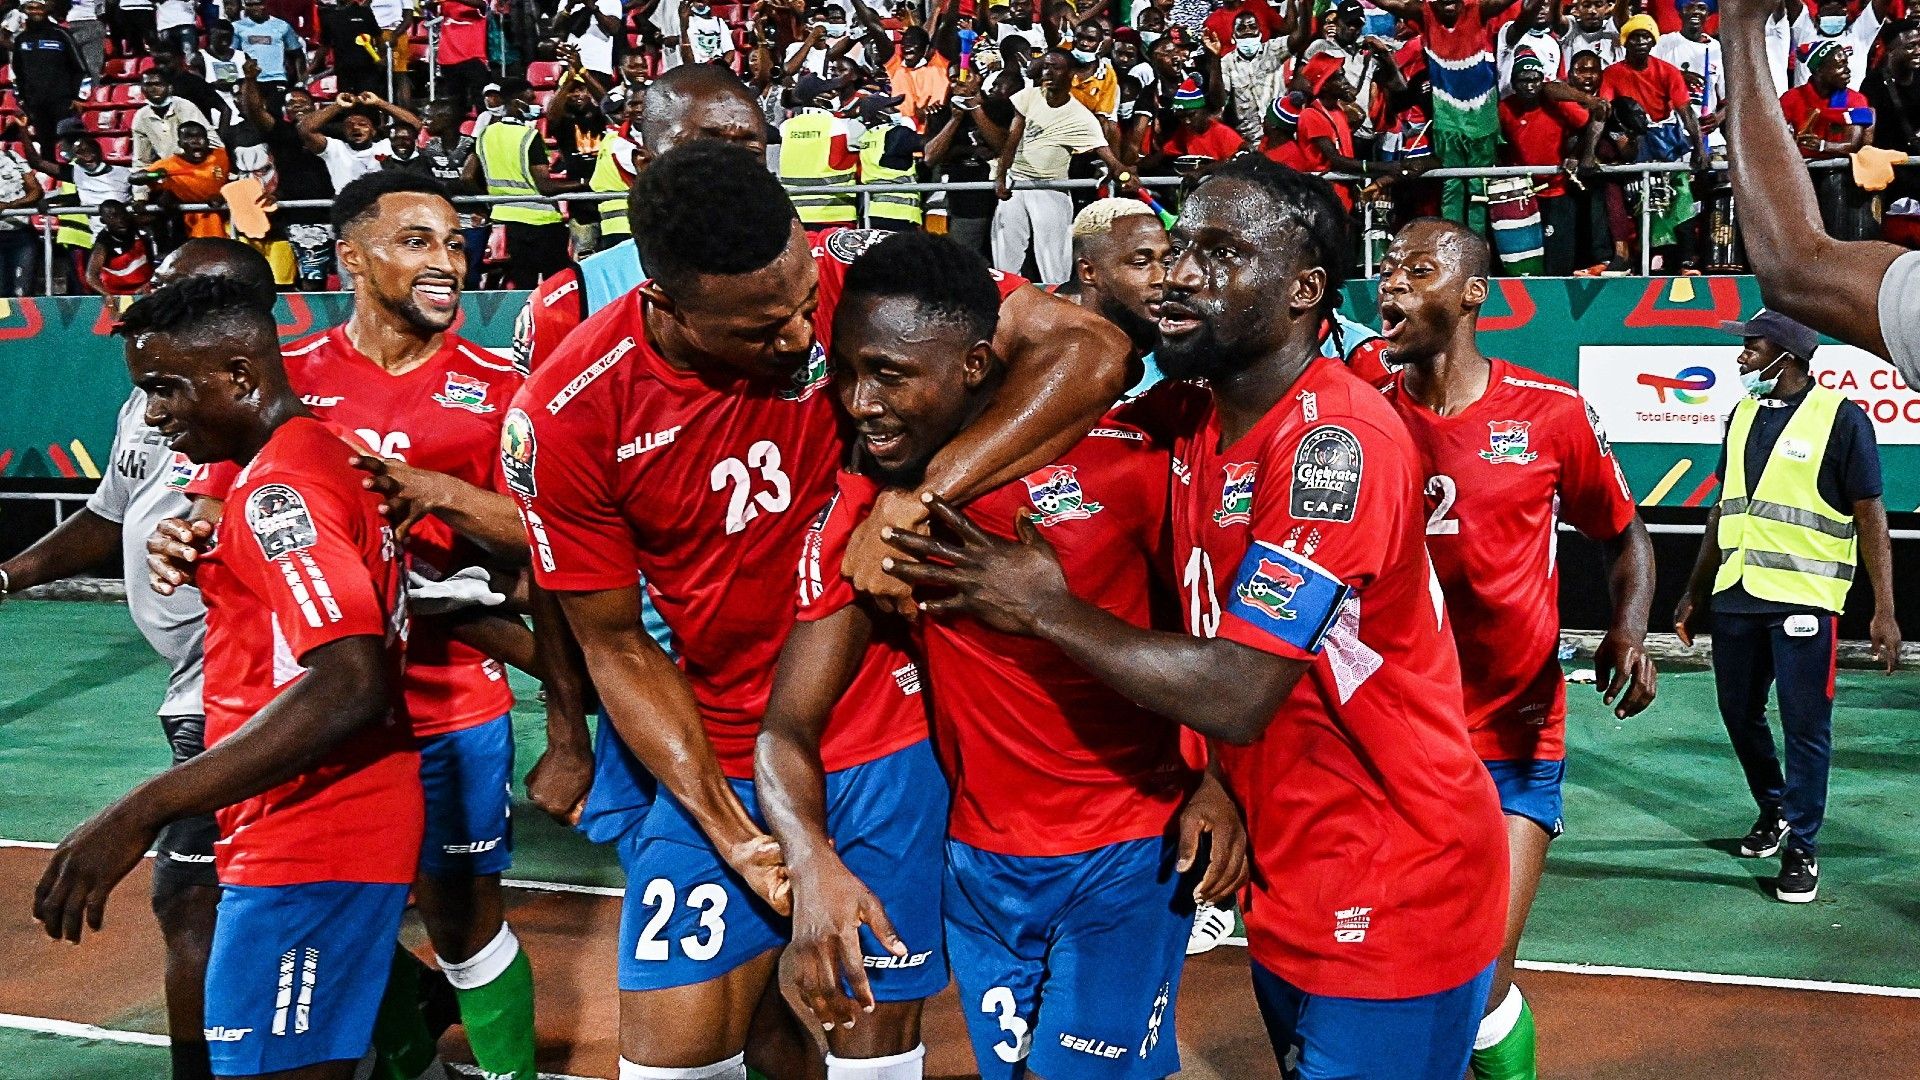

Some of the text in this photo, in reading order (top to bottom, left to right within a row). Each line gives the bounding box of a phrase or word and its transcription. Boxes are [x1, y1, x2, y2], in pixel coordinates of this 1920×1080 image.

[790, 130, 821, 139] SECURITY
[1810, 370, 1858, 390] CA
[1636, 411, 1716, 424] TotalEnergies
[1298, 463, 1358, 482] Celebrate
[711, 440, 791, 535] 23
[1304, 475, 1345, 491] Africa
[443, 837, 502, 854] saller
[635, 878, 728, 961] 23
[863, 950, 933, 968] saller
[981, 986, 1031, 1063] 3
[204, 1026, 253, 1042] aller
[1060, 1033, 1127, 1059] saller
